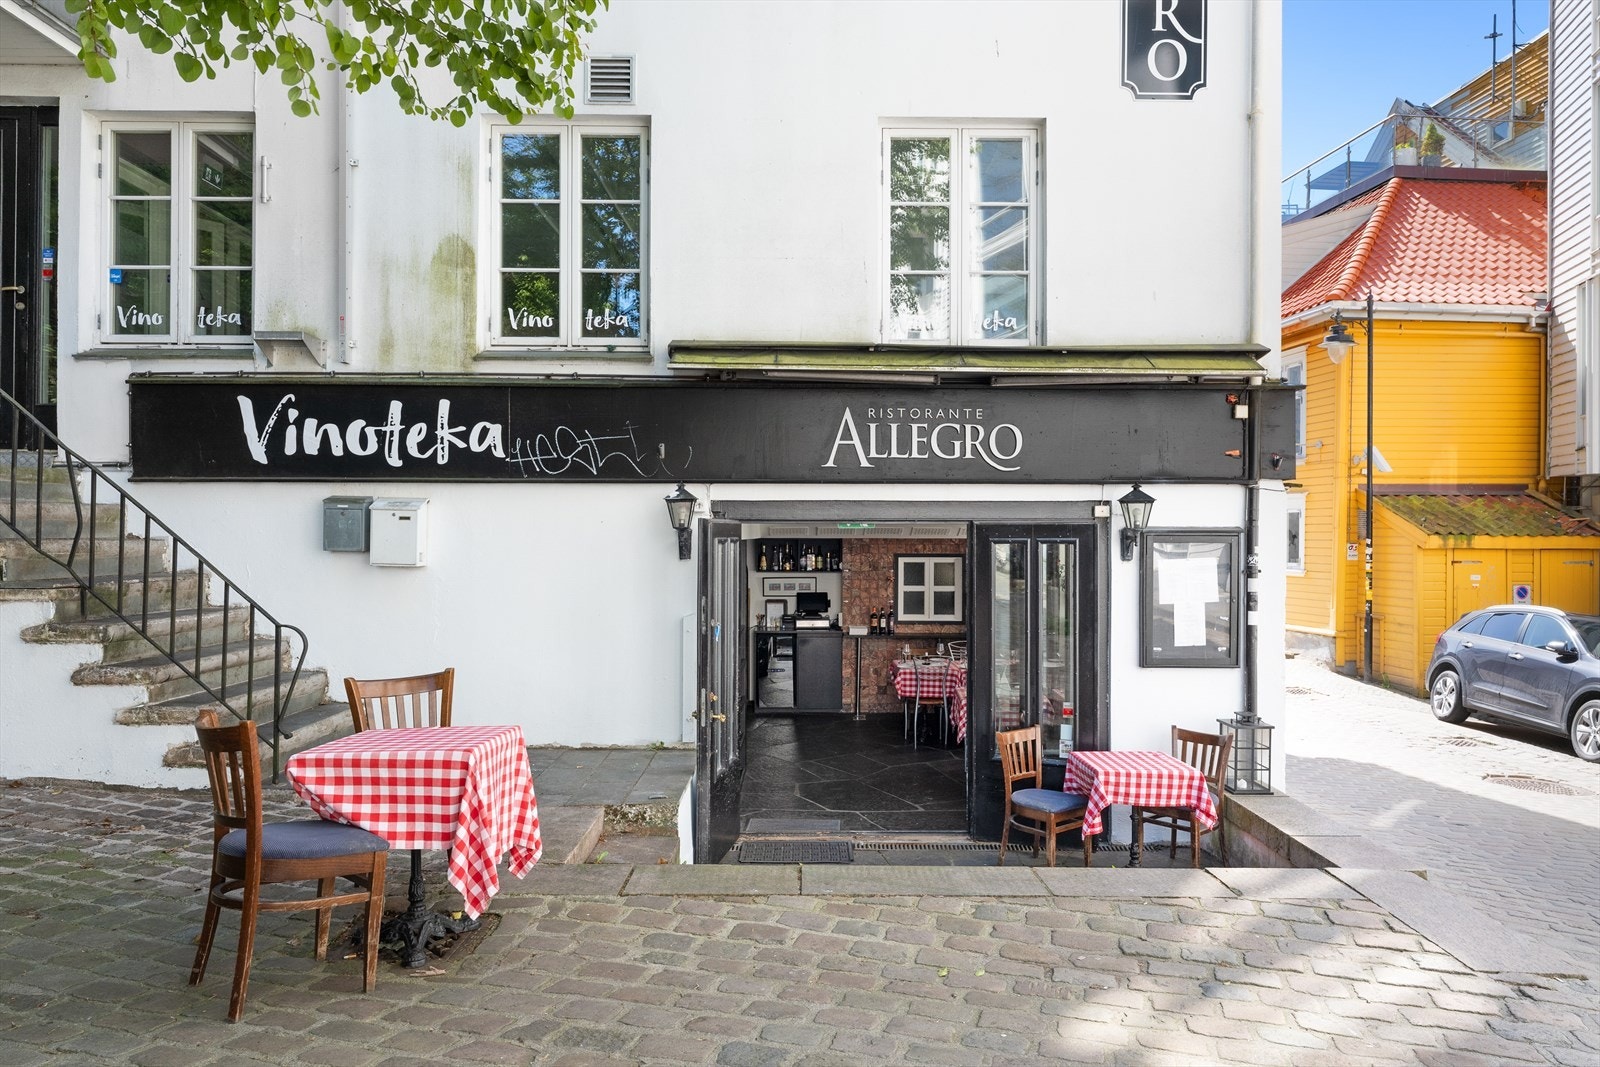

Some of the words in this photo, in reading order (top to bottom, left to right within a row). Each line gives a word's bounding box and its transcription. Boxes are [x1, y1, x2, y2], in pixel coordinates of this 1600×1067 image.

[1147, 0, 1203, 81] RO
[117, 305, 164, 328] Vino
[197, 306, 242, 328] teka
[507, 307, 554, 330] Vino
[585, 308, 629, 331] teka
[980, 310, 1018, 331] eka
[868, 408, 983, 419] RISTORANTE
[237, 393, 506, 467] Vinoteka
[821, 406, 1023, 471] ALLEGRO
